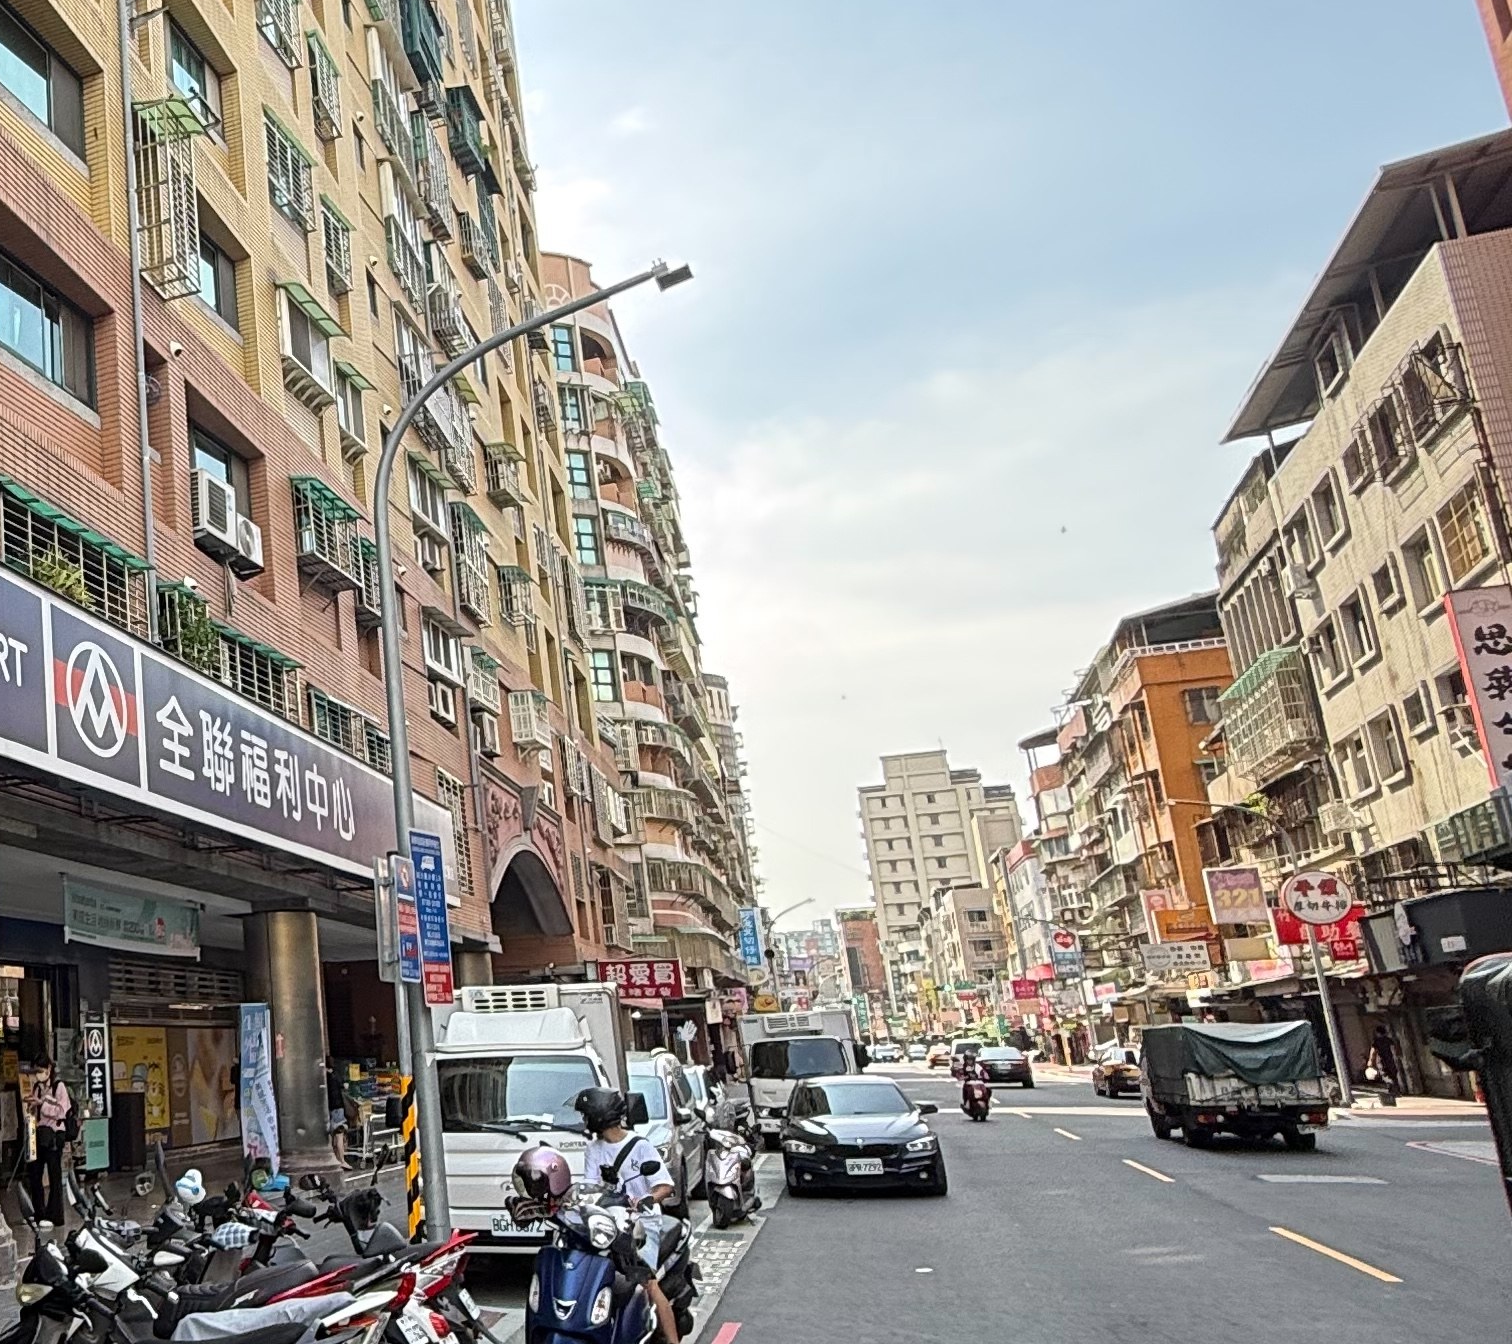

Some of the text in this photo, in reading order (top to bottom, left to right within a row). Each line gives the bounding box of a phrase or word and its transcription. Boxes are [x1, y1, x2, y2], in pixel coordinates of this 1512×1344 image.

[155, 694, 356, 843] 全聯福利中心
